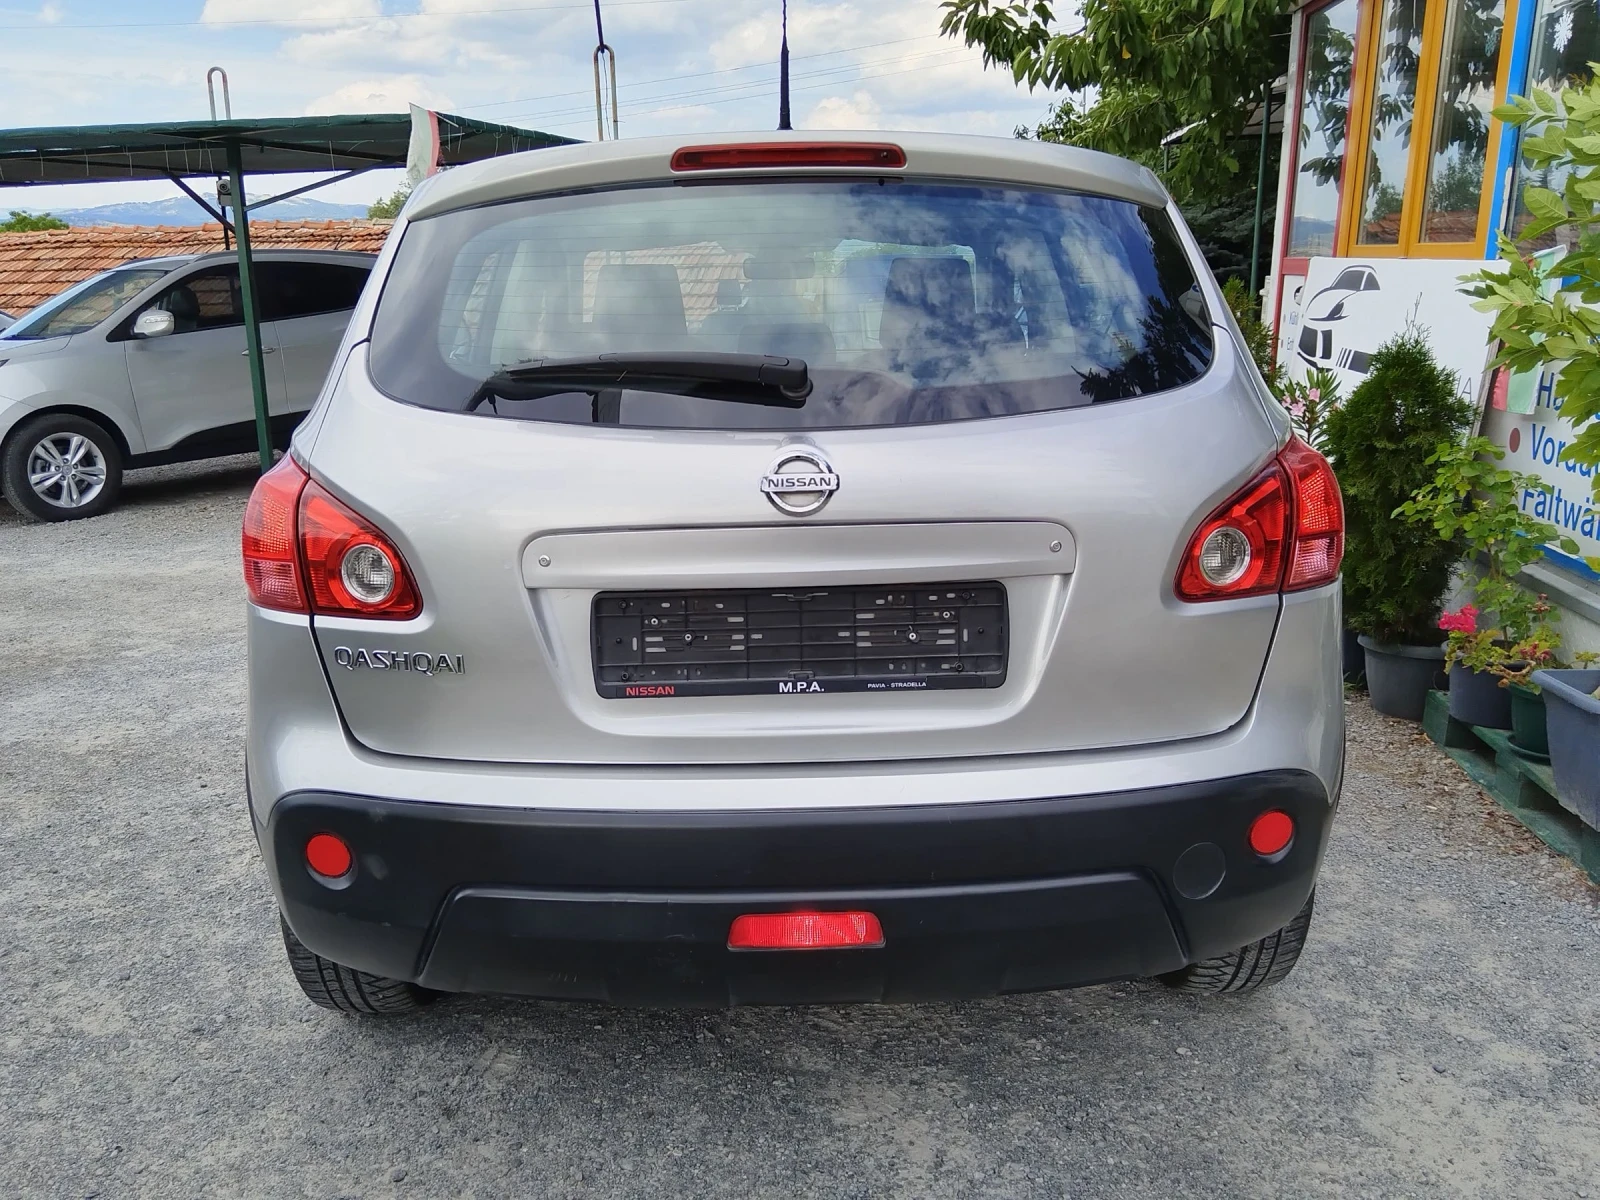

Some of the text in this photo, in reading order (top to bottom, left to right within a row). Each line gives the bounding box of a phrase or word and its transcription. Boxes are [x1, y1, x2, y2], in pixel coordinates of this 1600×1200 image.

[767, 477, 831, 488] NISSAN
[334, 646, 466, 676] QASHQAI
[625, 686, 675, 697] NISSAN
[778, 681, 825, 693] M.P.A.
